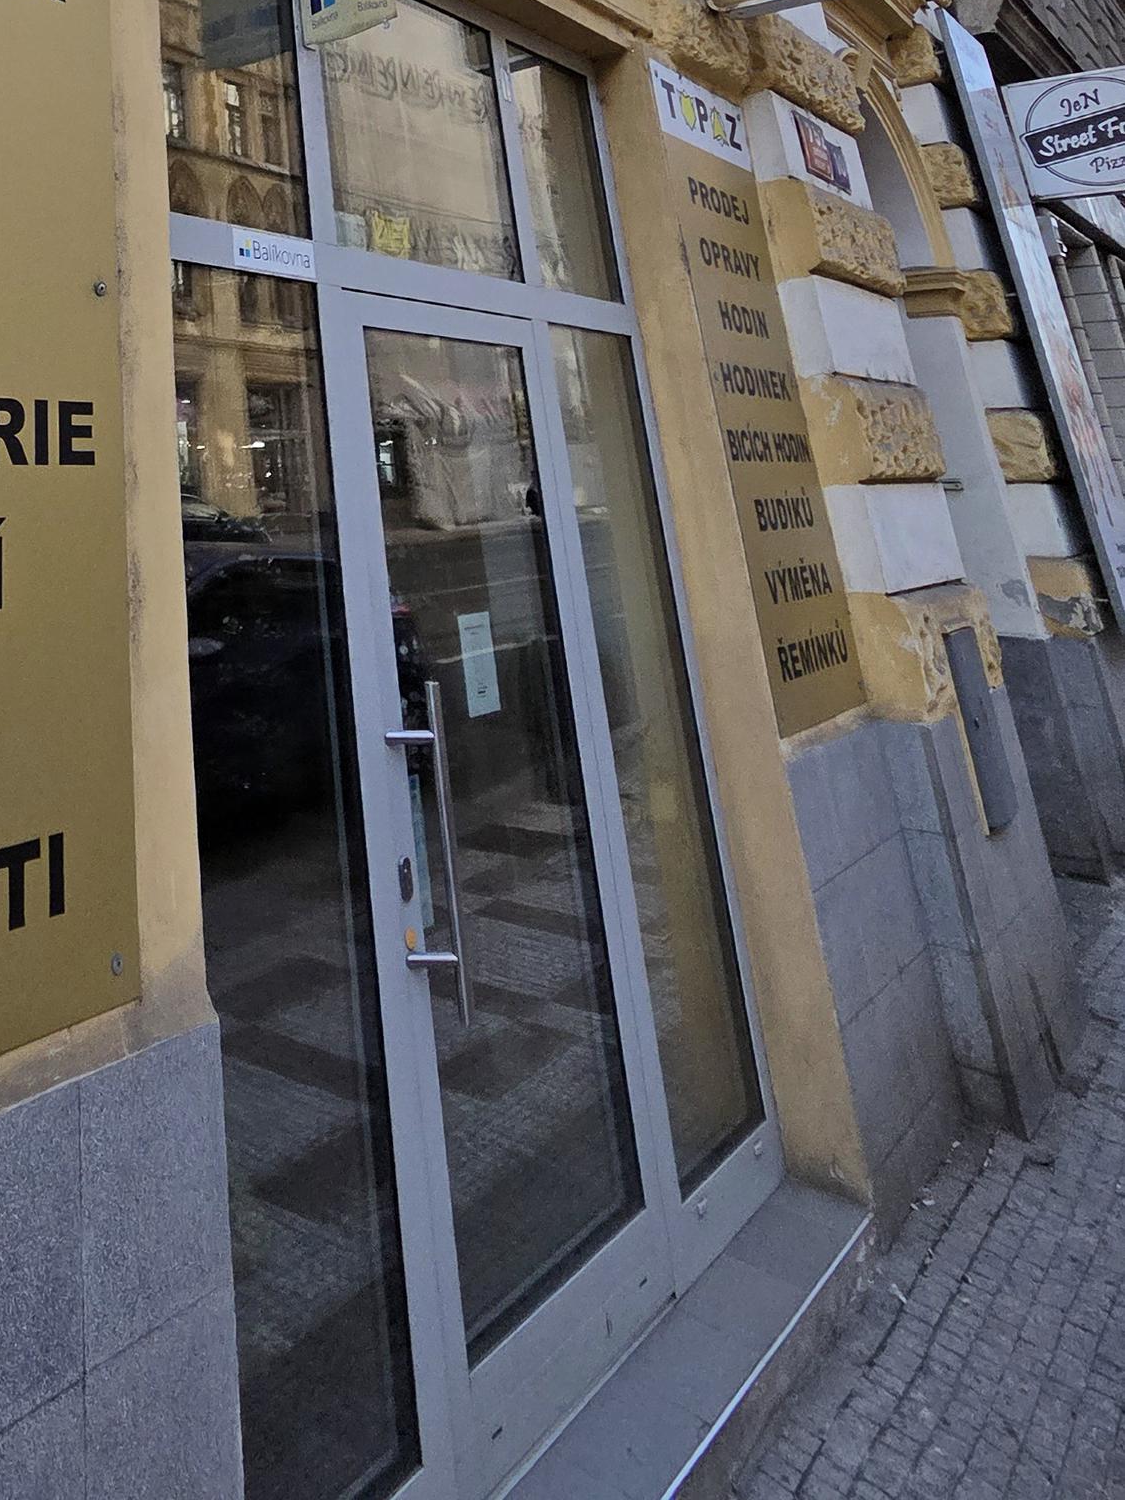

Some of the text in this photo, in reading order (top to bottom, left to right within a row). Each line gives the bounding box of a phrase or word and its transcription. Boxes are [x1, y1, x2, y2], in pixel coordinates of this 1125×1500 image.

[1037, 124, 1098, 157] Street
[687, 176, 750, 225] PRODEJ
[699, 237, 761, 282] OPRAVY
[717, 300, 770, 339] HODIN
[720, 362, 792, 402] HODINEK
[726, 422, 813, 463] BICÍCH HODIN
[753, 487, 815, 532] BUDÍKŮ
[764, 557, 833, 605] VÝMĚNA
[777, 618, 849, 683] ŘEMÍNKŮ
